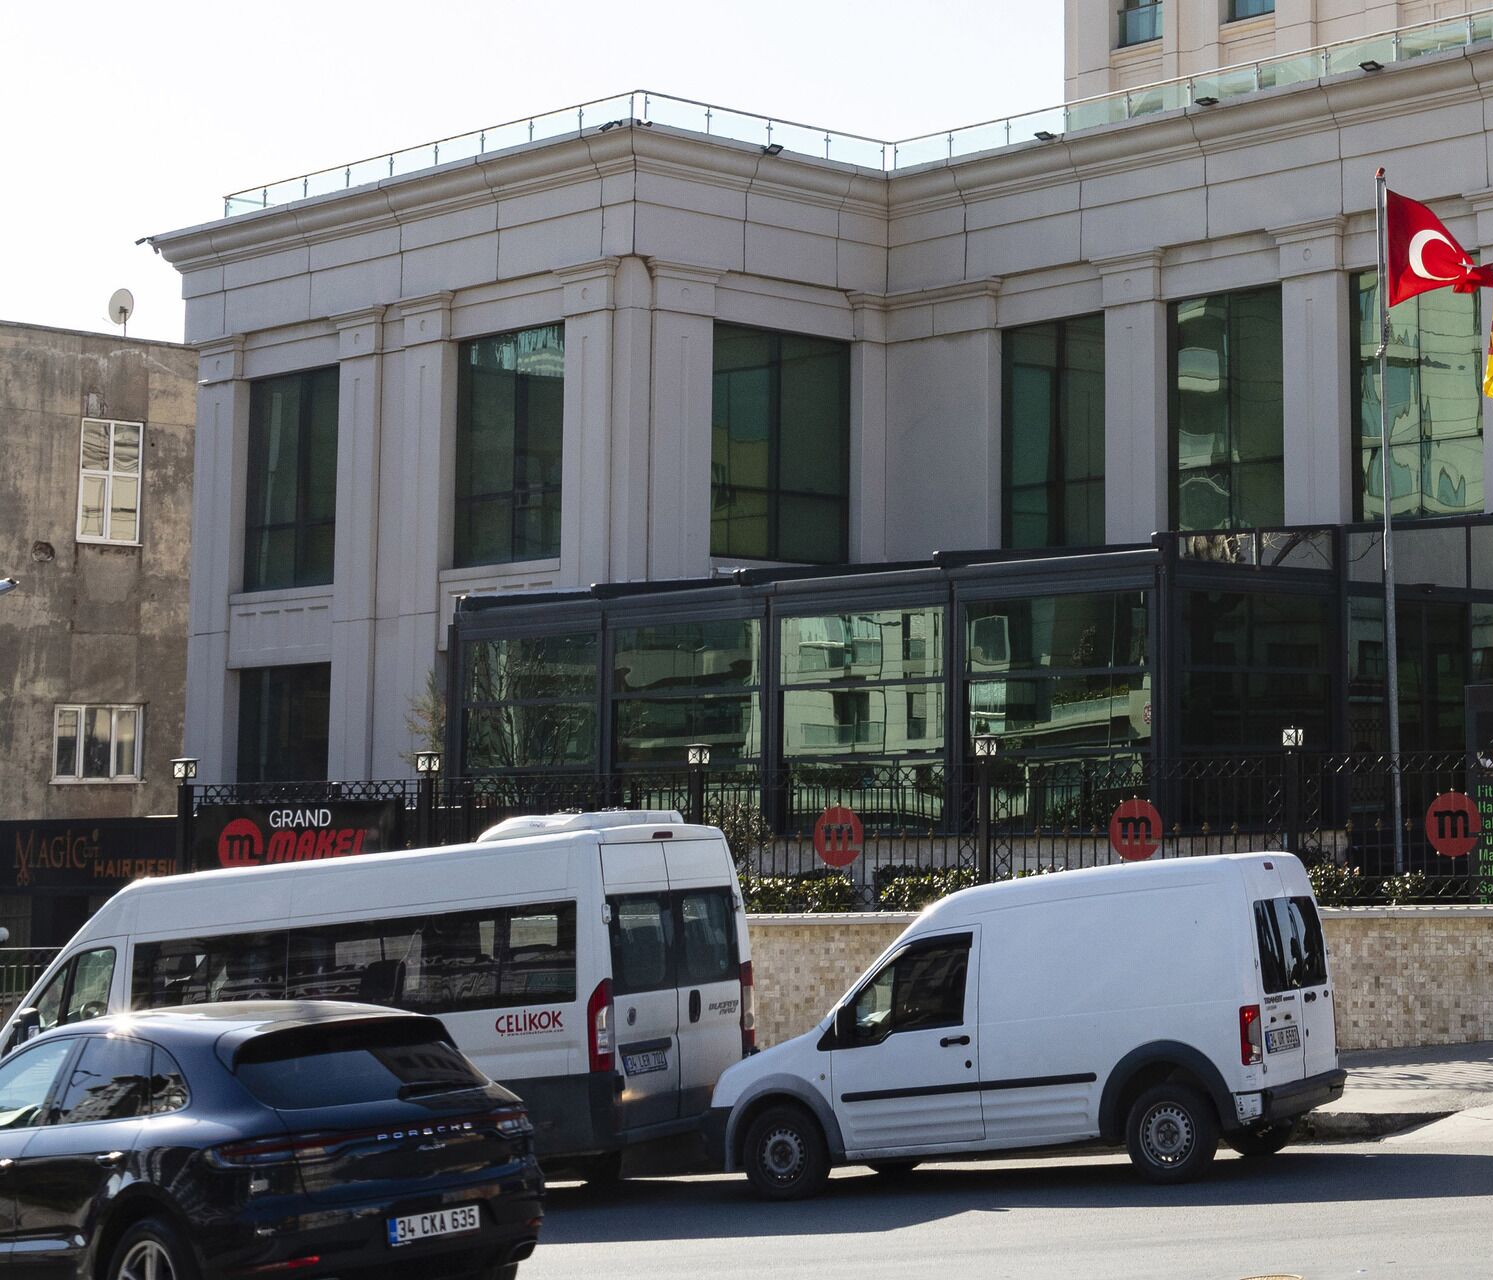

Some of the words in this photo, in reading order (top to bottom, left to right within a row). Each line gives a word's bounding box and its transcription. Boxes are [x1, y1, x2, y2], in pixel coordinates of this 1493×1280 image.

[269, 809, 332, 828] GRAND
[94, 860, 130, 878] HAIR
[377, 1122, 473, 1140] PORSCHE
[398, 1220, 416, 1239] 34
[420, 1214, 448, 1235] CKA
[450, 1207, 477, 1230] 635
